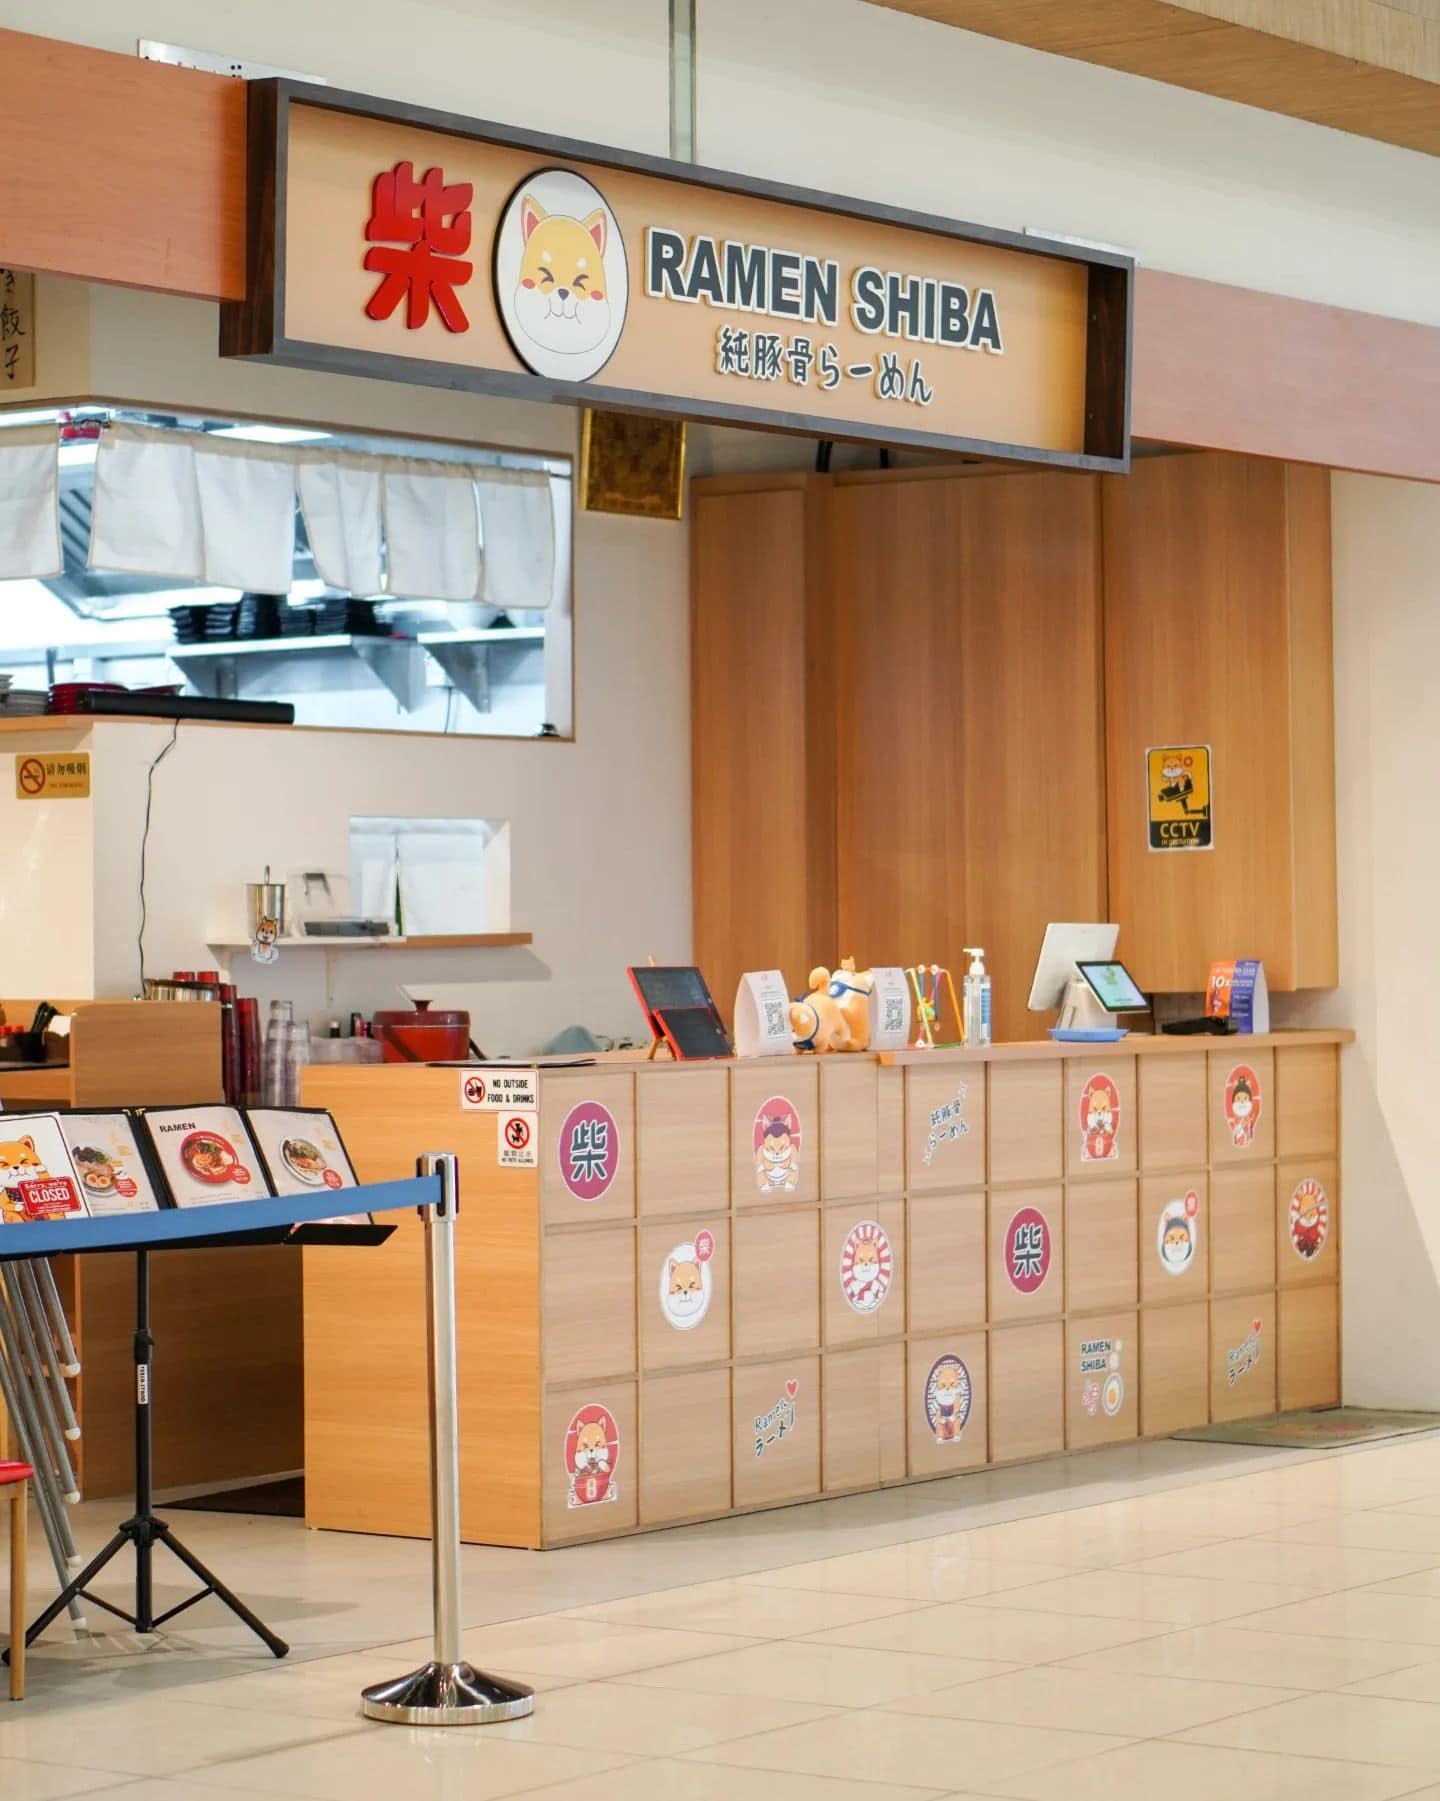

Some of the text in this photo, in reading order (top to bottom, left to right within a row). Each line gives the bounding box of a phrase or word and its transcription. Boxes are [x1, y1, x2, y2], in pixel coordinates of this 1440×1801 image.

[365, 161, 473, 333] 柴
[648, 229, 1003, 353] RAMEN SHIBA
[719, 326, 934, 405] 純豚骨らーめん
[1160, 821, 1200, 838] CCTV
[493, 1079, 529, 1089] NO OUTSIDE
[487, 1094, 504, 1103] FOOD
[513, 1095, 534, 1104] DRINKS
[159, 1122, 197, 1134] RAMEN
[571, 1120, 608, 1182] 柴
[29, 1187, 70, 1204] CLOSED
[1014, 1223, 1042, 1278] 柴
[1081, 1340, 1111, 1354] RAMEN
[1081, 1358, 1107, 1372] SHIBA
[755, 1407, 794, 1457] ラーメン
